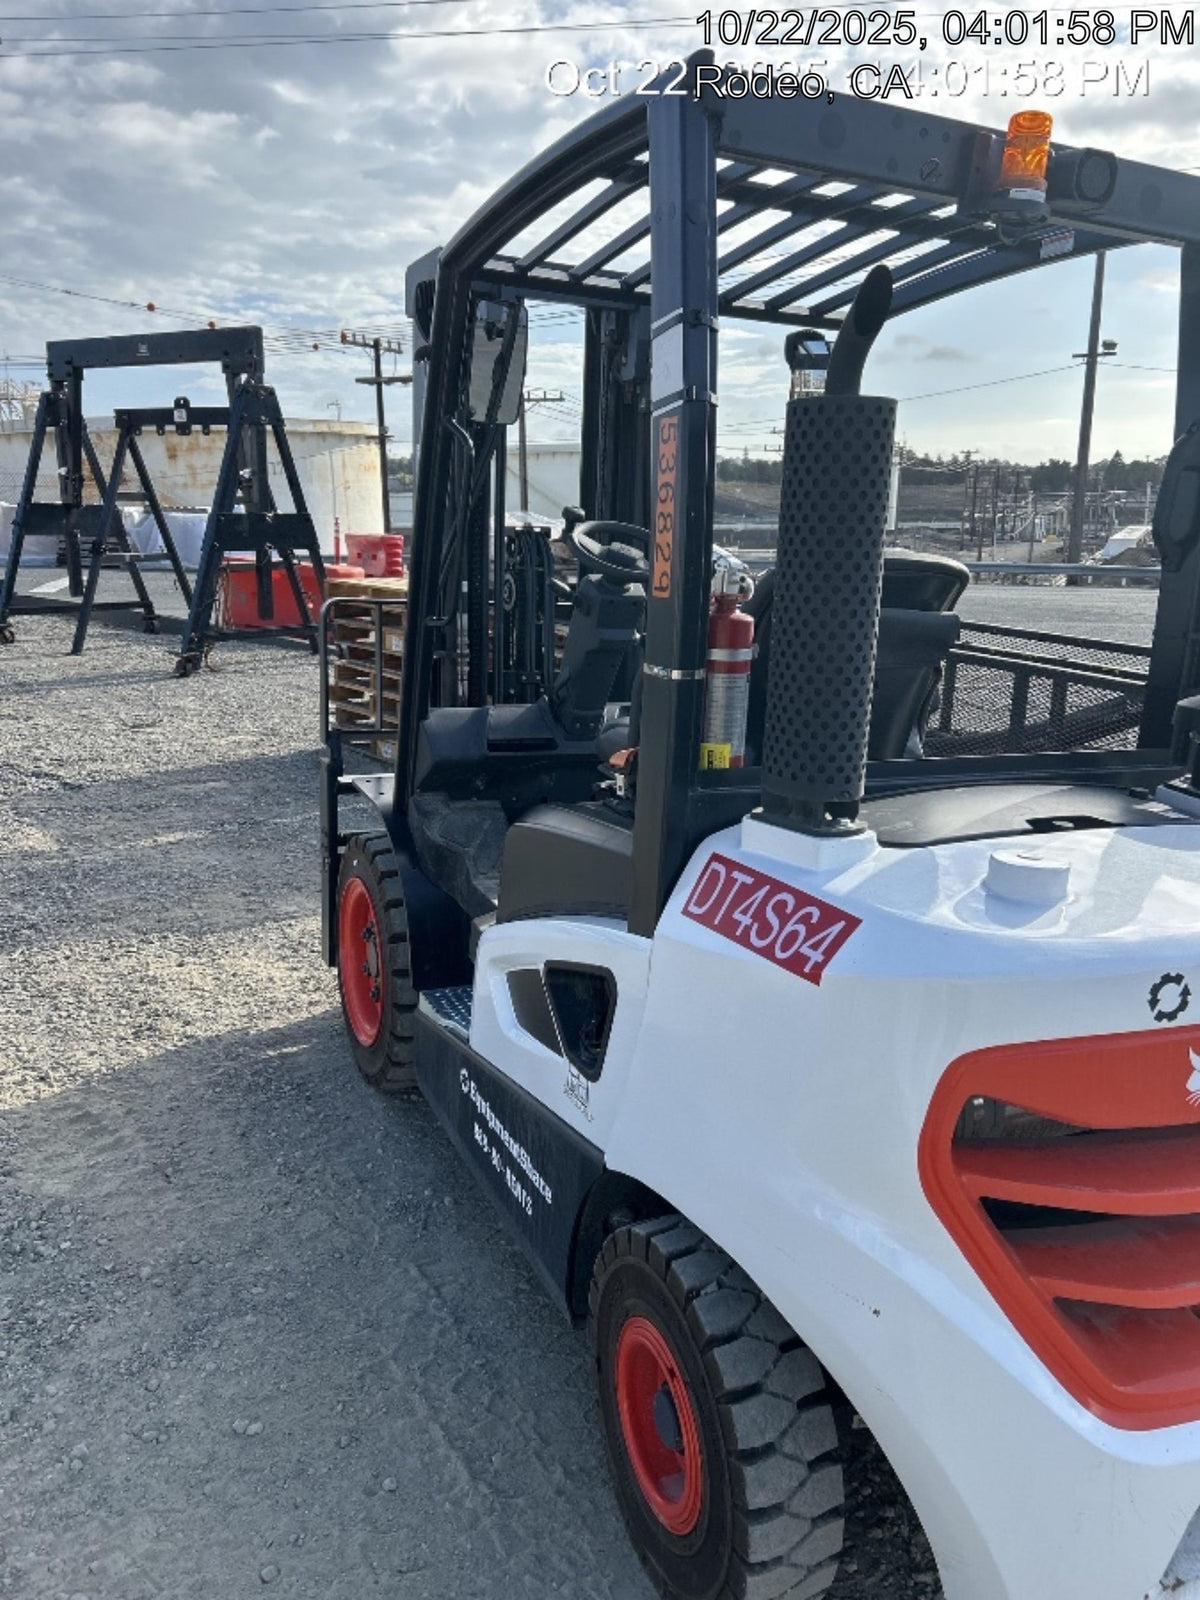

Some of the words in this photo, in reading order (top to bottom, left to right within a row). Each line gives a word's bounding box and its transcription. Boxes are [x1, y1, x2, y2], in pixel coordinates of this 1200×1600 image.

[653, 421, 677, 594] 536829
[688, 861, 846, 974] DT4S64
[470, 1080, 552, 1204] EquipmentShare
